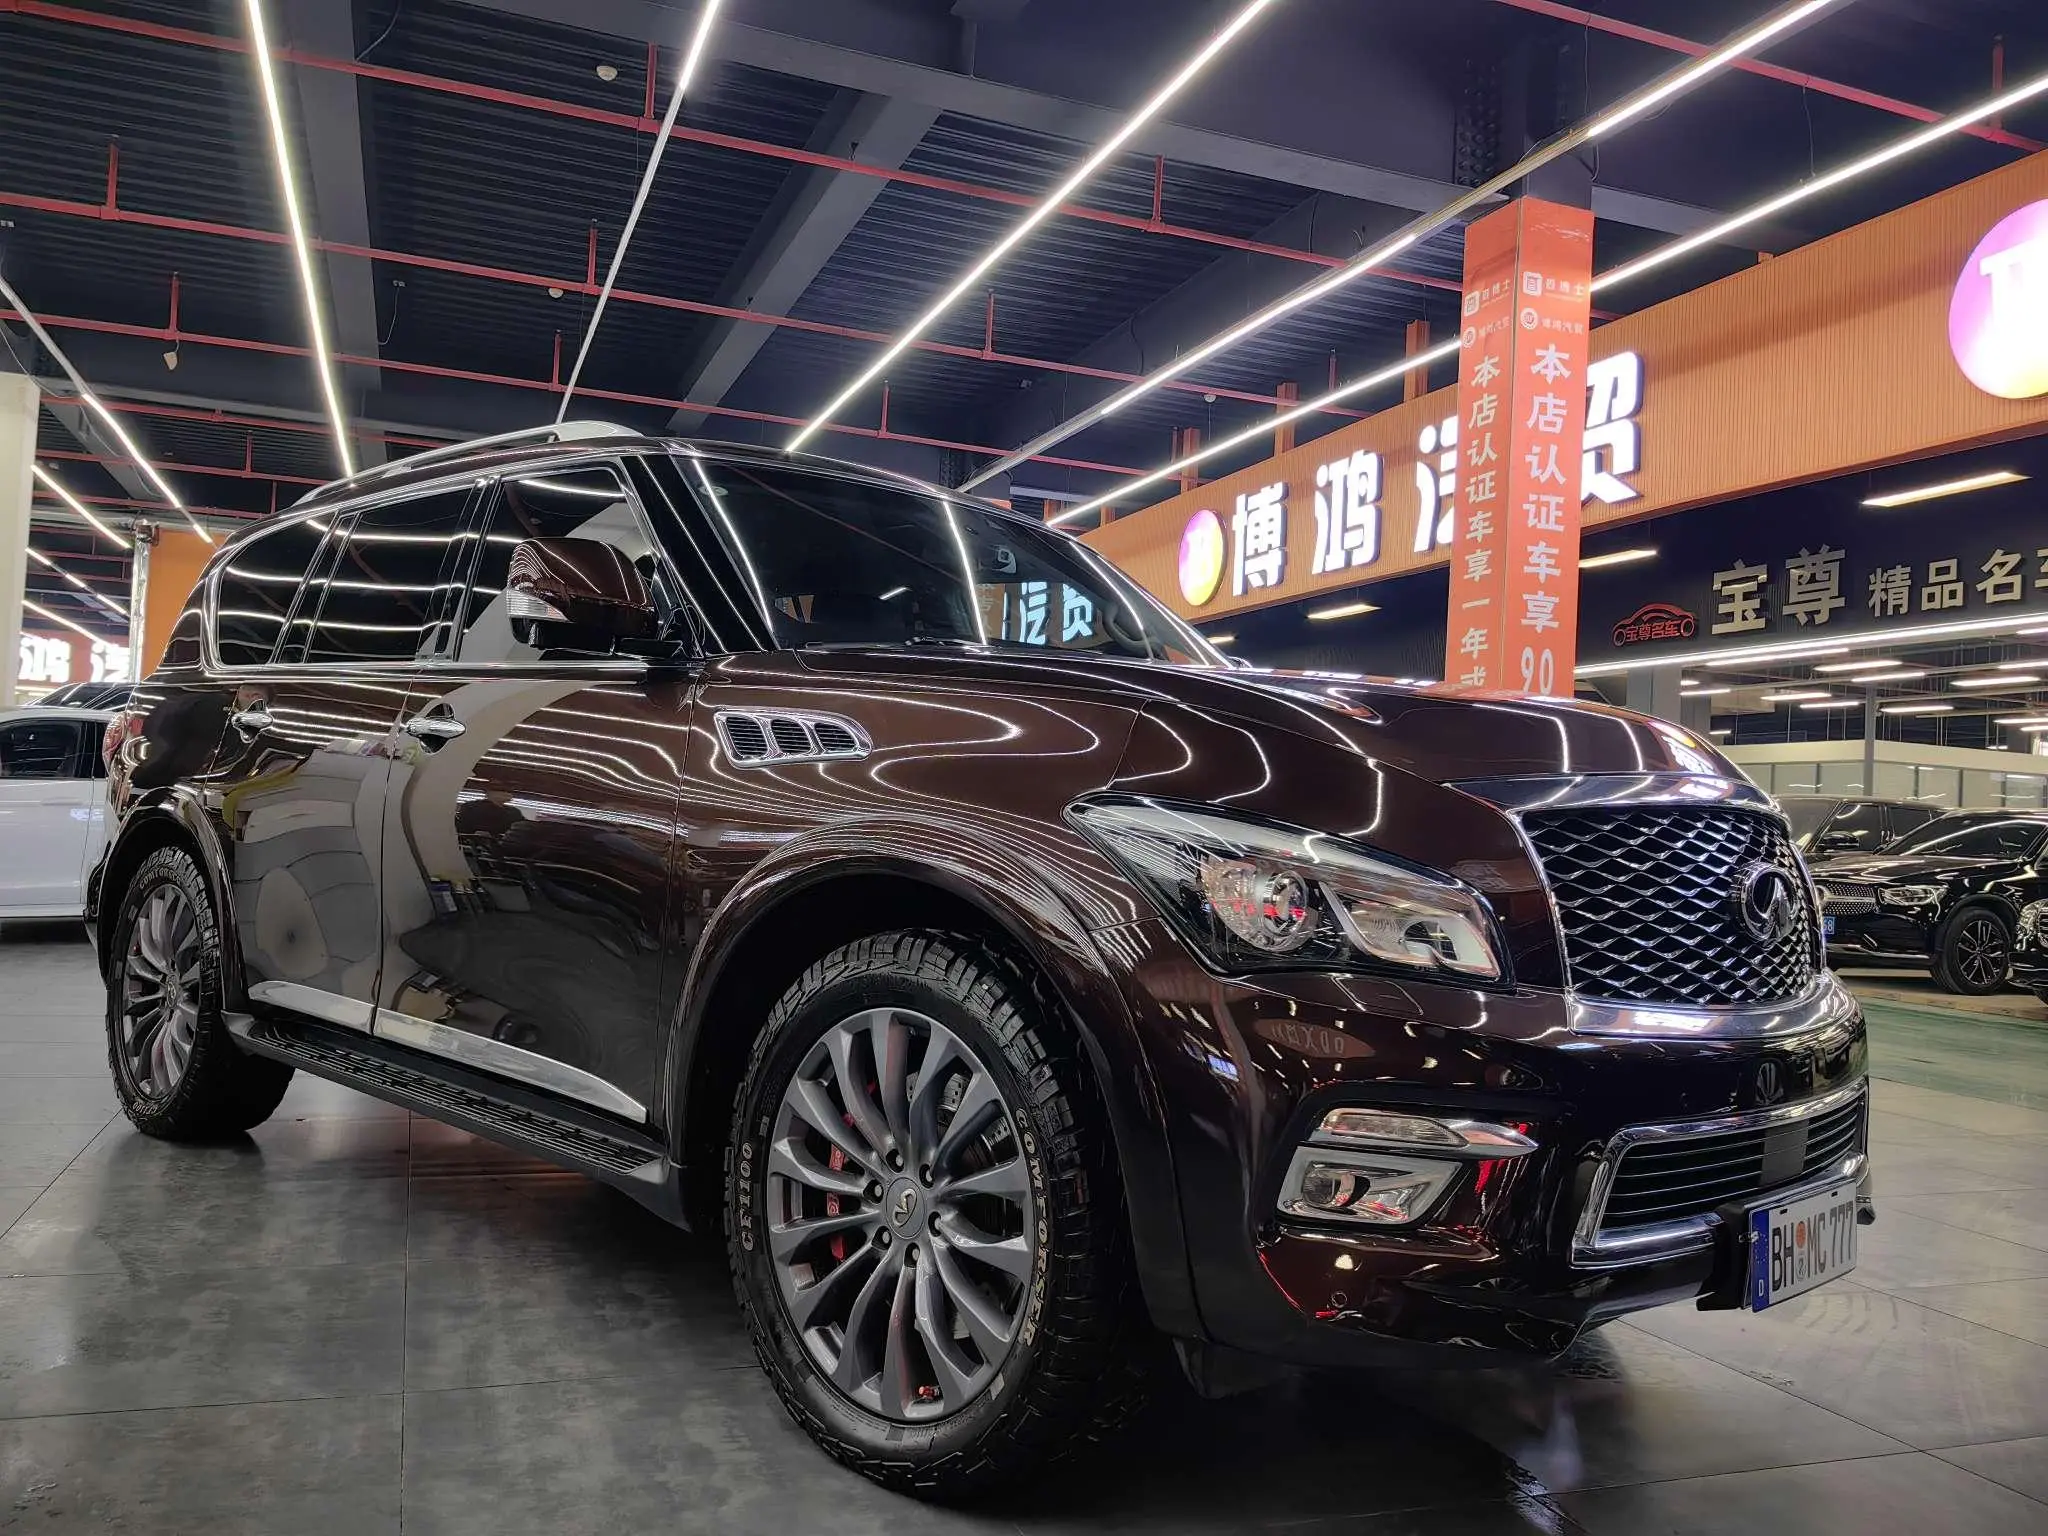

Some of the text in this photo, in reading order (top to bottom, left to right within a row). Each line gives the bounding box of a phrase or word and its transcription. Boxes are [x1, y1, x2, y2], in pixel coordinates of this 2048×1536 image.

[1625, 620, 1681, 642] 宝尊名车
[1711, 544, 2048, 634] 宝尊 精品名
[1015, 1107, 1050, 1347] COMFORSER
[1772, 1200, 1853, 1292] BH MC 777
[1758, 1279, 1765, 1297] D
